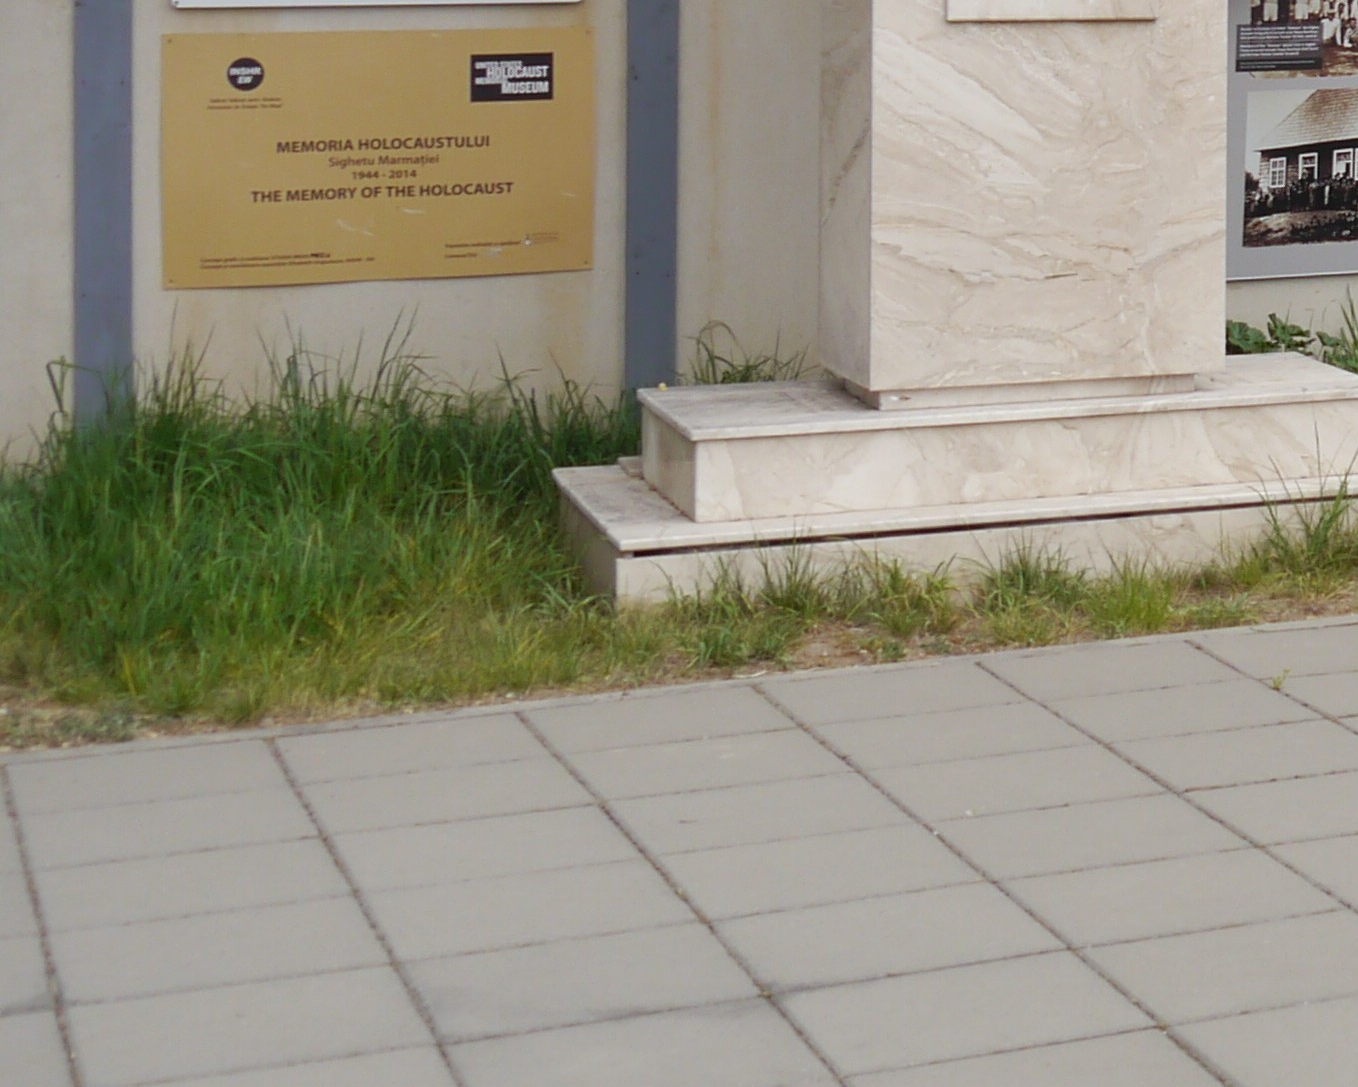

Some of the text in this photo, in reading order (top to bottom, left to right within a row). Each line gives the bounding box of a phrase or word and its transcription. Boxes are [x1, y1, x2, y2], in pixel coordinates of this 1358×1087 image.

[501, 81, 549, 94] MUSEUM
[277, 136, 490, 153] MEMORIA HOLOCAUSTULUI
[328, 156, 375, 169] Sighetu
[352, 170, 379, 180] 1944
[389, 169, 417, 180] 2014
[251, 182, 514, 203] THE MEMORY OF THE HOLOCAUST
